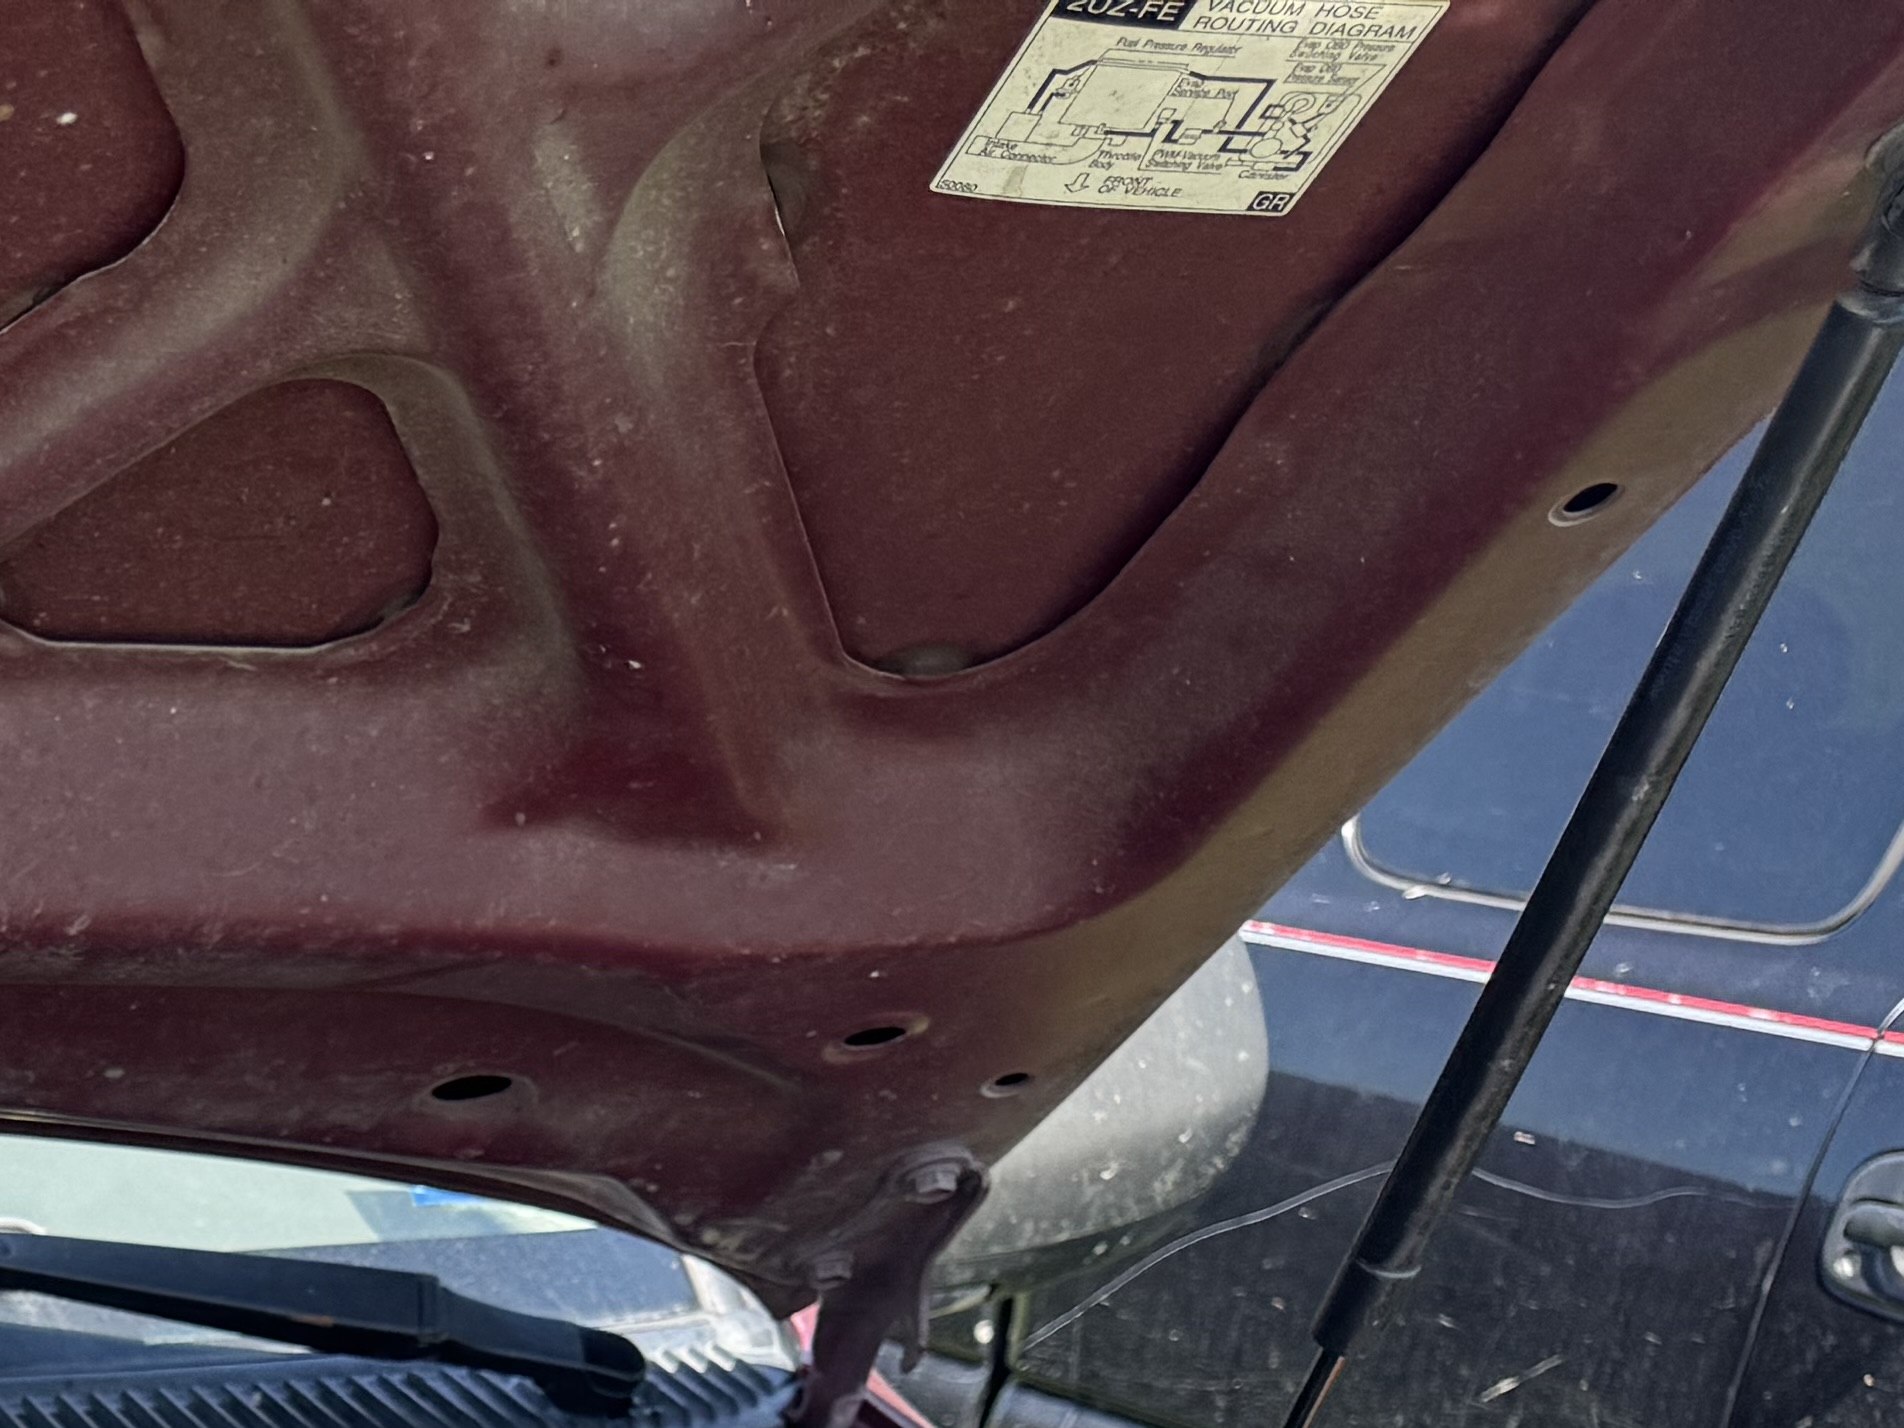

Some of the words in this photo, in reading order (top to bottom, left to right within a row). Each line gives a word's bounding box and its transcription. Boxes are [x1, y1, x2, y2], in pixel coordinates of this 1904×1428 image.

[1207, 0, 1307, 17] VACUUM
[1314, 3, 1385, 20] HOSE
[1192, 16, 1299, 34] ROUTING
[1308, 21, 1418, 40] DIAGRAM
[1124, 185, 1183, 197] VEHICLE
[1253, 193, 1290, 210] GR
